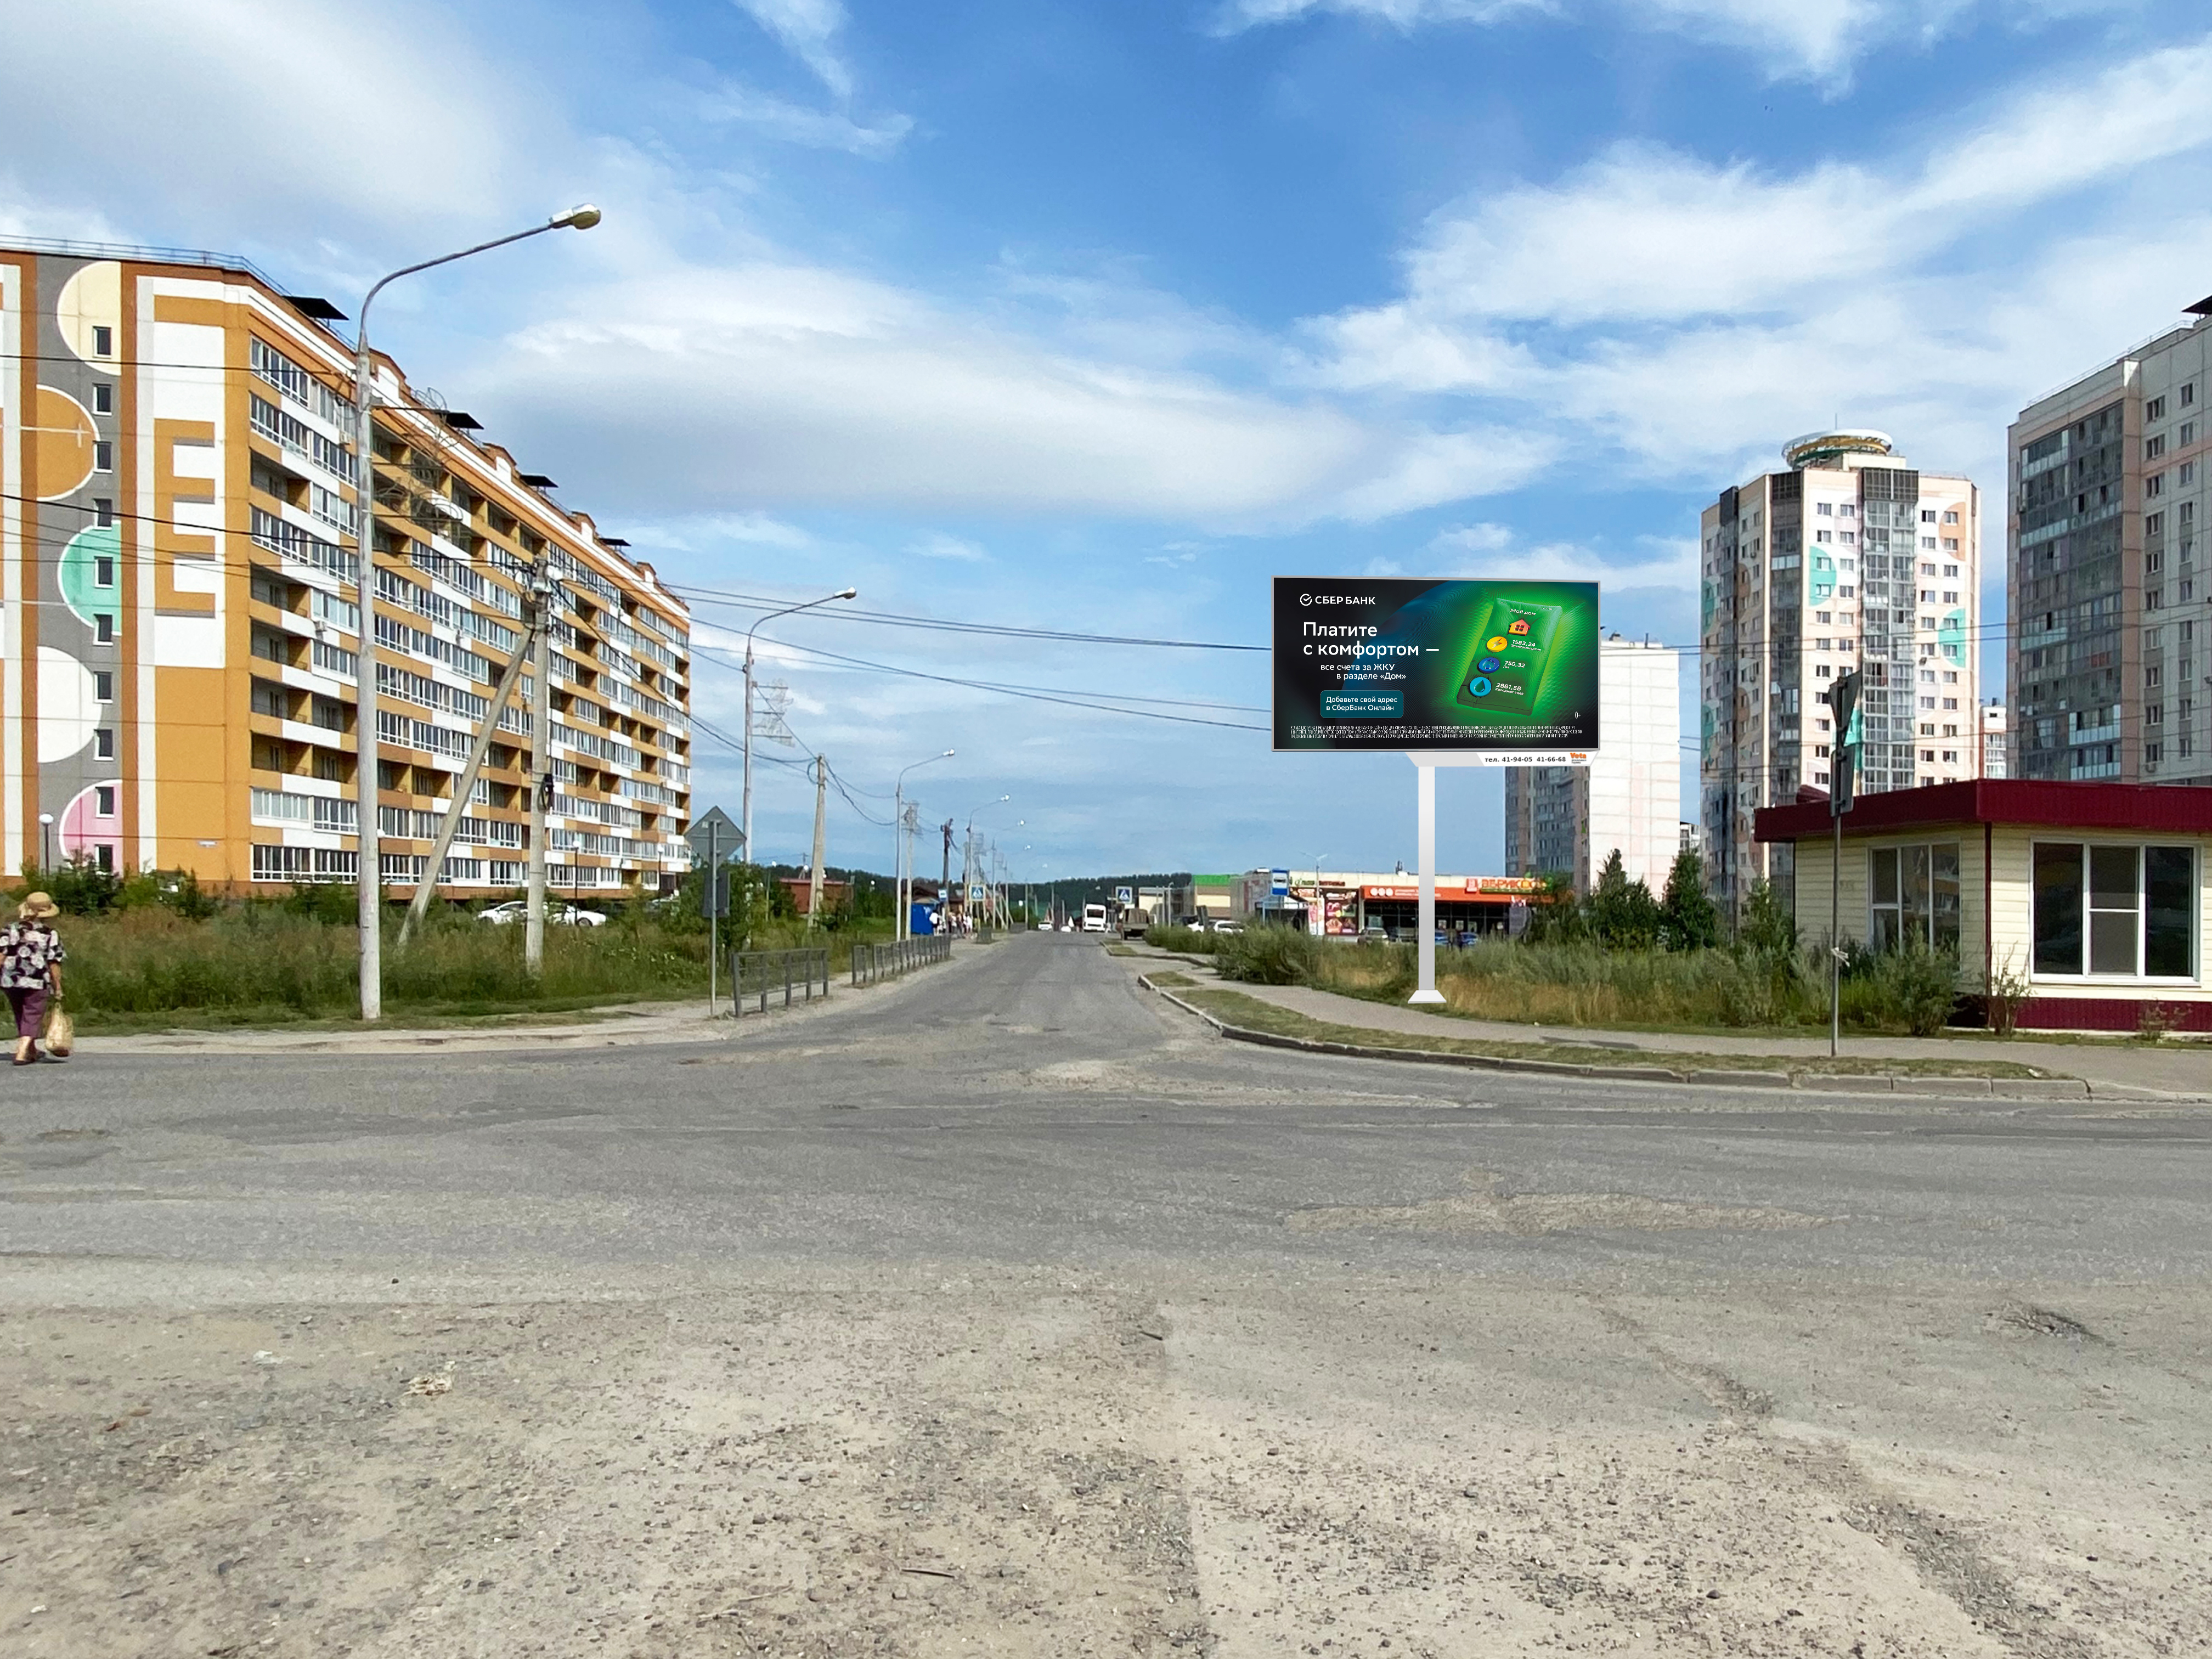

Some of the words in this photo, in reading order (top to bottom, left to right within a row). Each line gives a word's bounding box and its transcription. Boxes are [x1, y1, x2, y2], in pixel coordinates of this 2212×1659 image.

[1304, 622, 1378, 637] Платите
[1303, 644, 1312, 655] с
[1318, 640, 1419, 659] комфортом
[1380, 672, 1407, 681] «Дом»
[1496, 682, 1521, 691] 2881,58
